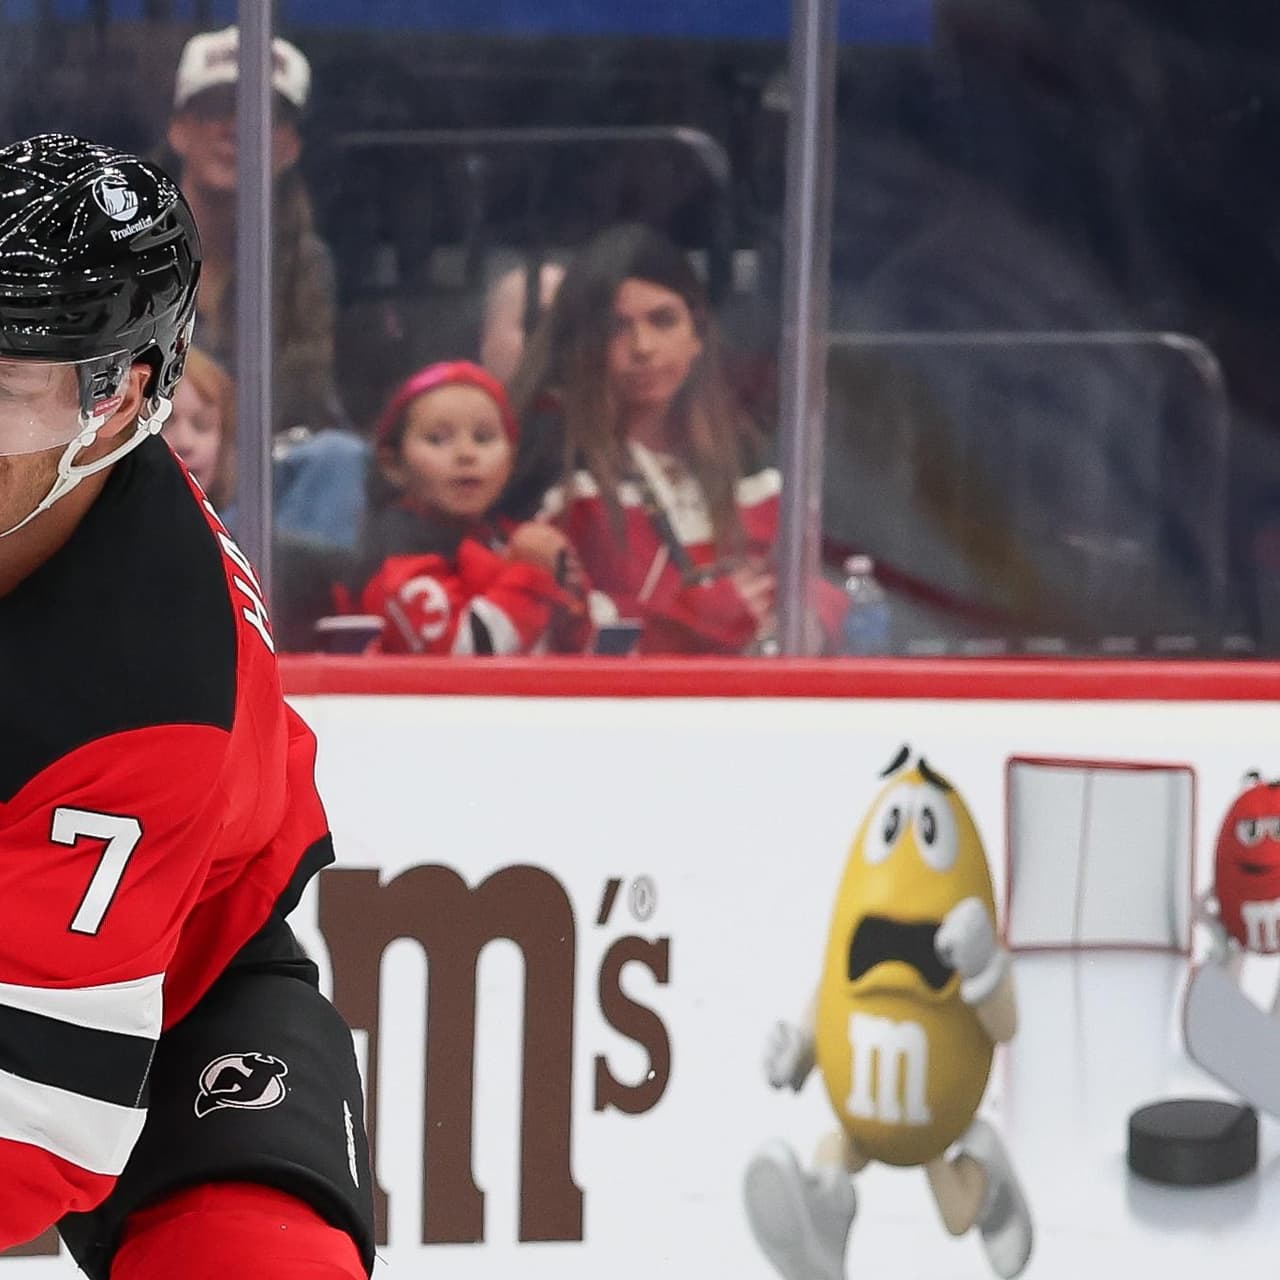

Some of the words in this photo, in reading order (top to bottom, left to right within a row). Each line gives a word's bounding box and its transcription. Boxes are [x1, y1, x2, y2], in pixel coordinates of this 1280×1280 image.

[109, 214, 154, 243] Prudential
[50, 806, 143, 935] 7
[847, 1012, 931, 1126] m
